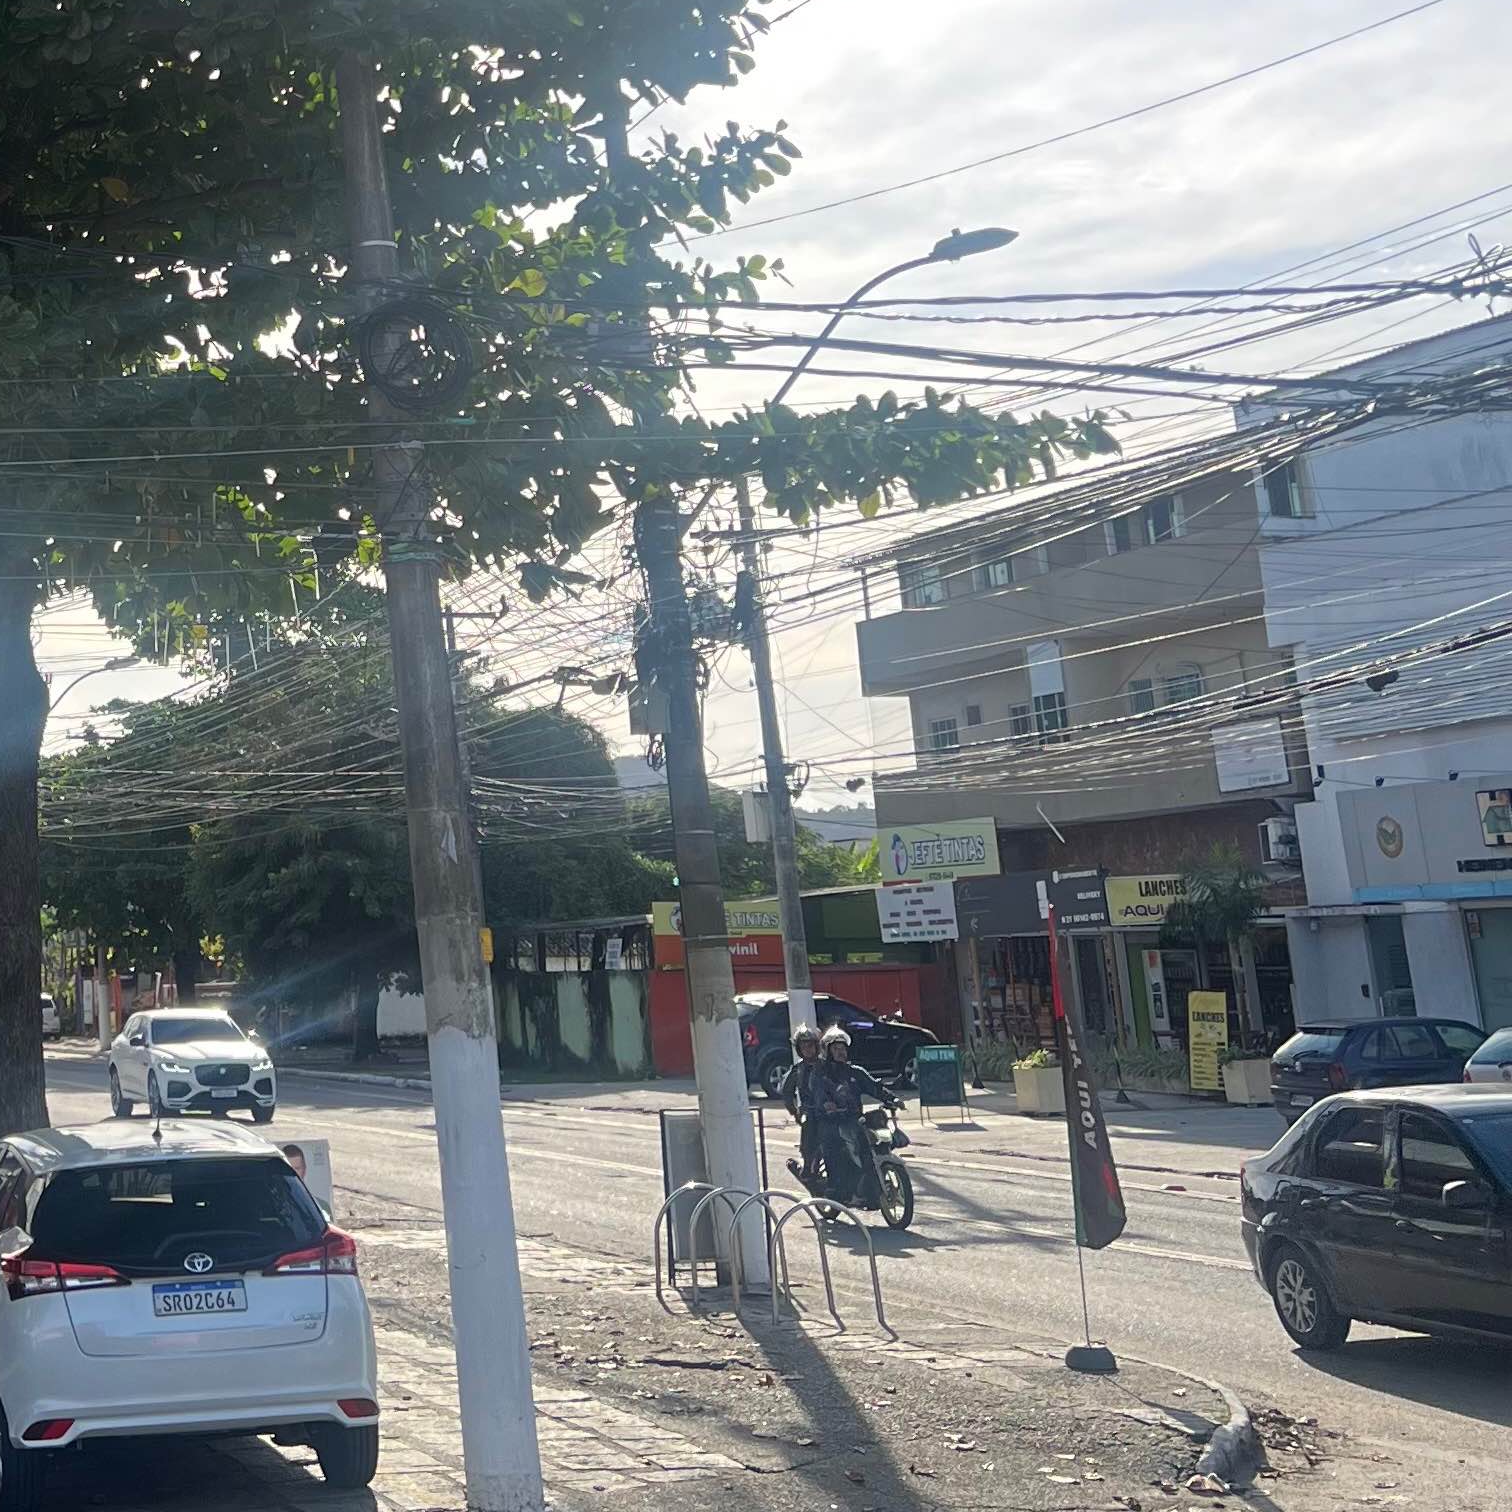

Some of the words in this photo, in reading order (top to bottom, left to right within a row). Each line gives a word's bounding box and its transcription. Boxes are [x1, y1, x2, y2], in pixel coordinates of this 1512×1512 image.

[943, 834, 986, 864] TINTAS
[1139, 879, 1188, 898] LANCHES
[732, 912, 780, 928] TINTAS
[1123, 903, 1166, 918] AQUI
[1077, 1080, 1098, 1151] AQUI
